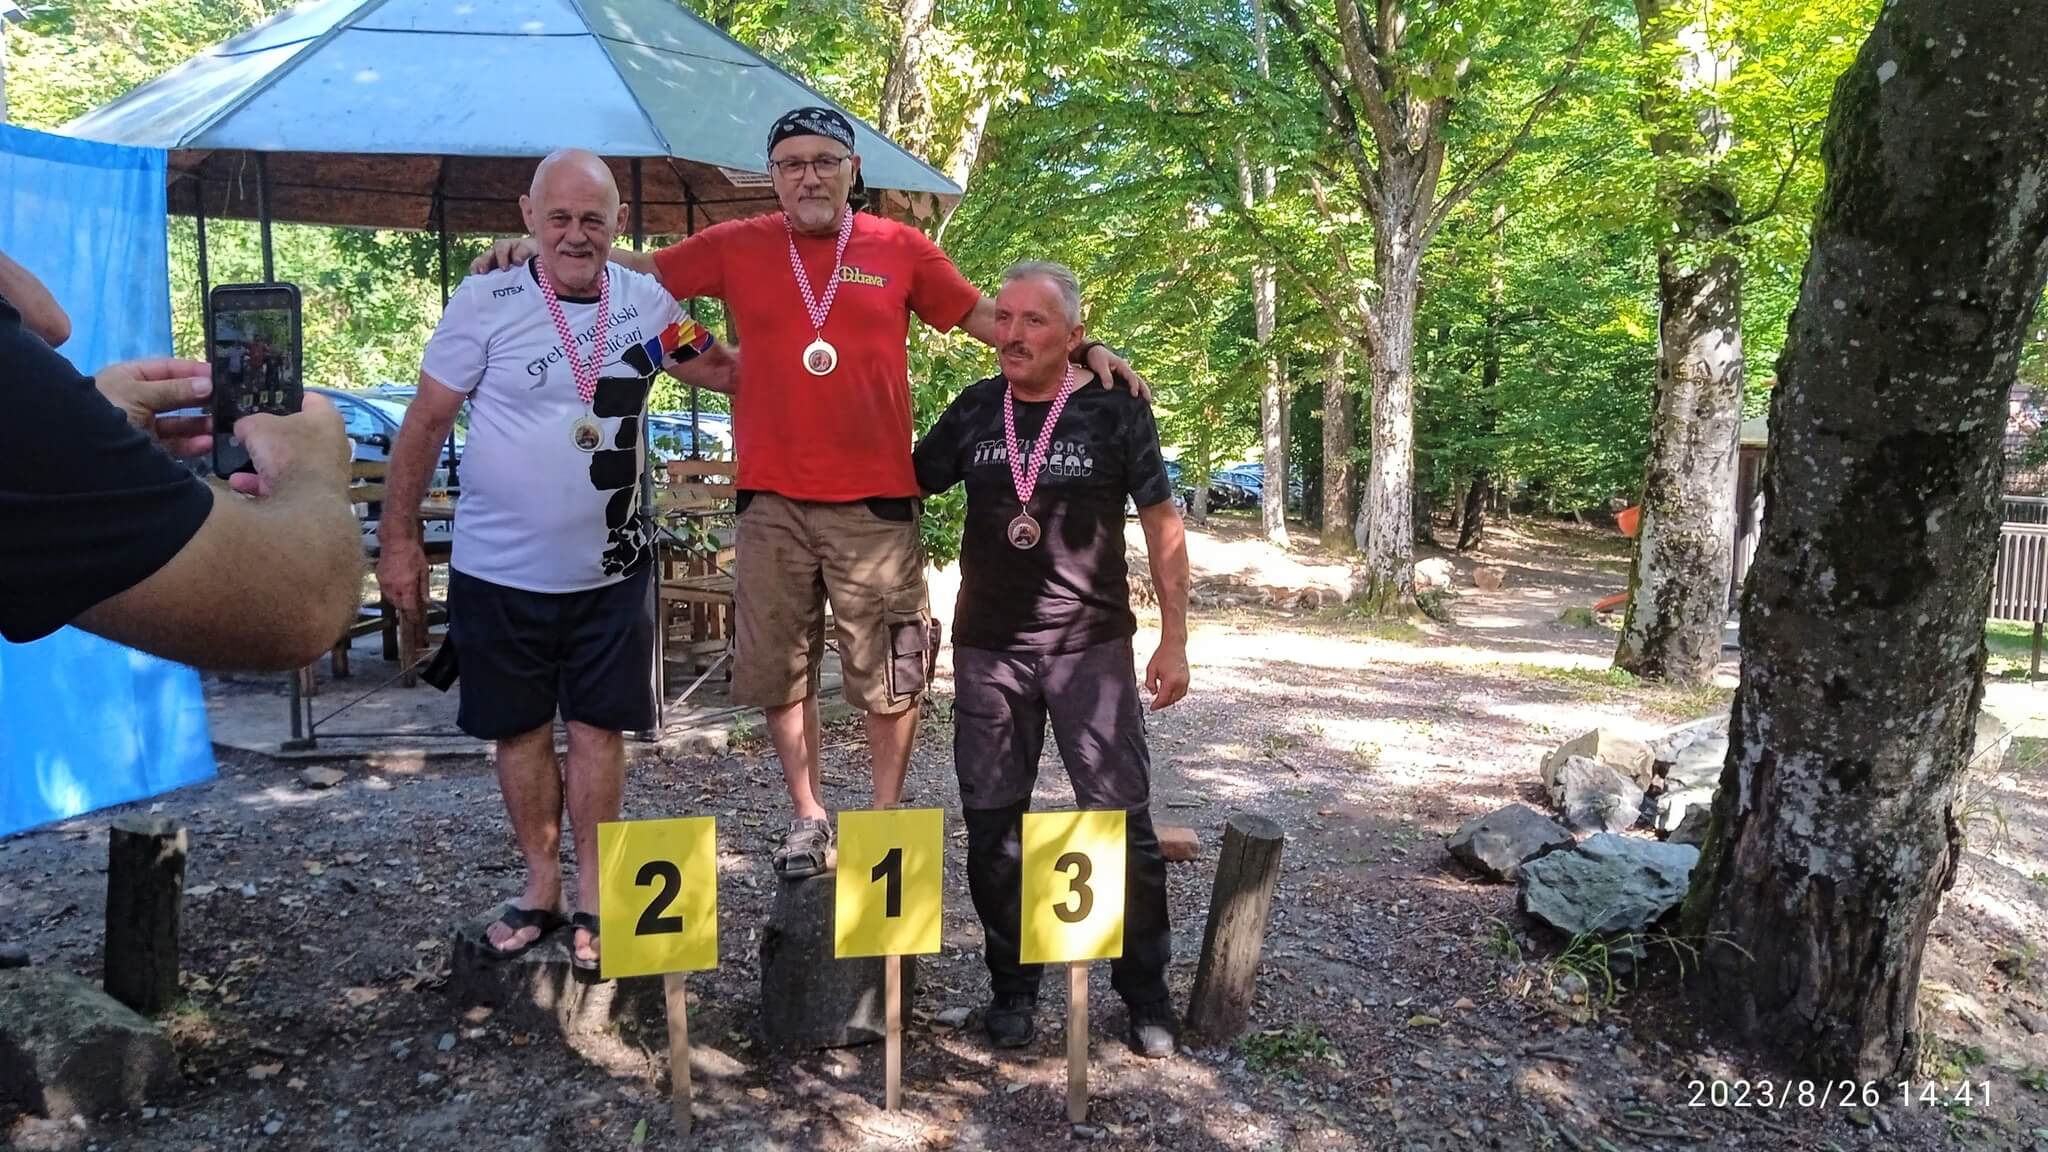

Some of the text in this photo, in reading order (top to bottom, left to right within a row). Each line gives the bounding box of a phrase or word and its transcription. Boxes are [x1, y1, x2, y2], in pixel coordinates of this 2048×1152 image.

[492, 285, 525, 299] FOTEX
[634, 860, 683, 937] 2
[871, 848, 902, 918] 1
[1053, 851, 1094, 923] 3
